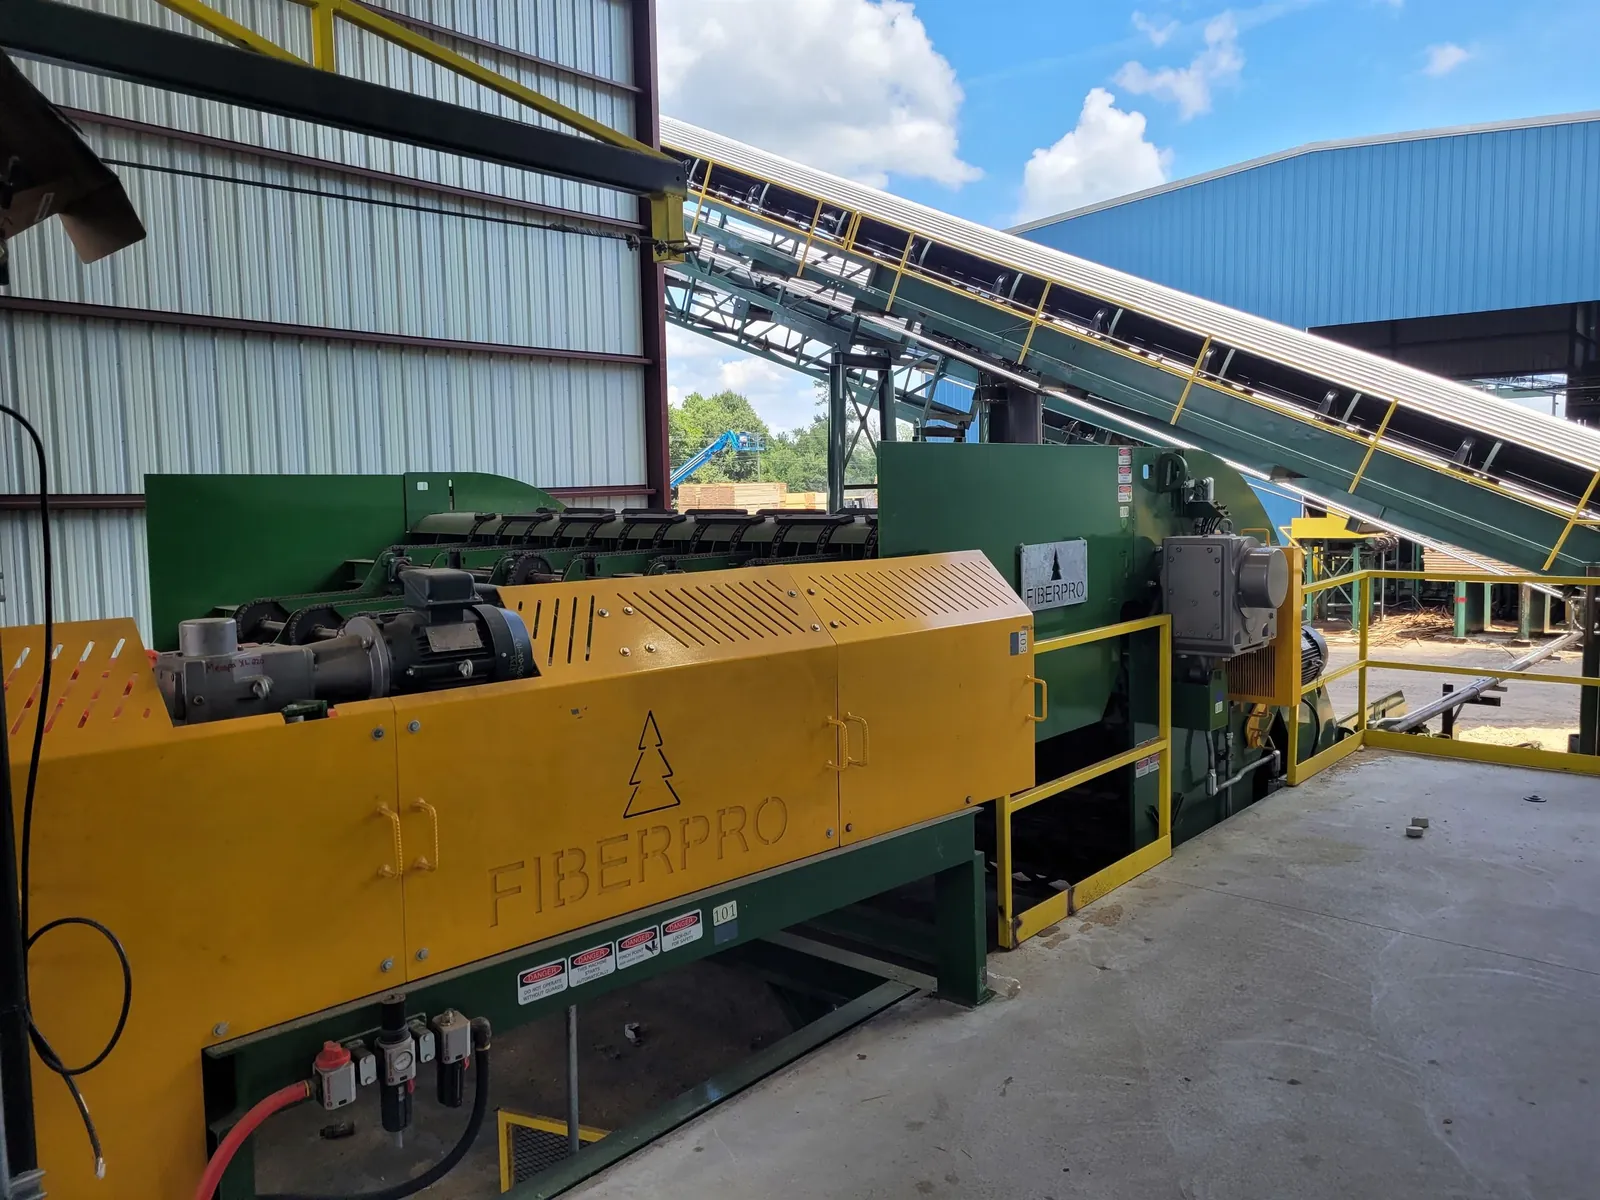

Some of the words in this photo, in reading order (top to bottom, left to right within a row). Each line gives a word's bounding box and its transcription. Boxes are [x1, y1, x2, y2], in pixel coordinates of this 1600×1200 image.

[1026, 581, 1085, 605] FIBERPRO
[1019, 630, 1027, 653] 103
[489, 796, 788, 927] FIBERPRO
[713, 904, 737, 923] 101
[669, 917, 693, 931] DANGER
[625, 932, 650, 946] DANGER
[578, 949, 605, 964] DANGER
[527, 966, 558, 982] DANGER
[577, 965, 587, 973] THIS
[584, 966, 600, 977] STARTS
[523, 987, 532, 996] DO
[532, 985, 542, 994] NOT
[542, 979, 562, 989] OPERATE
[523, 990, 544, 1001] WITHOUT
[545, 984, 564, 994] GUARDS
